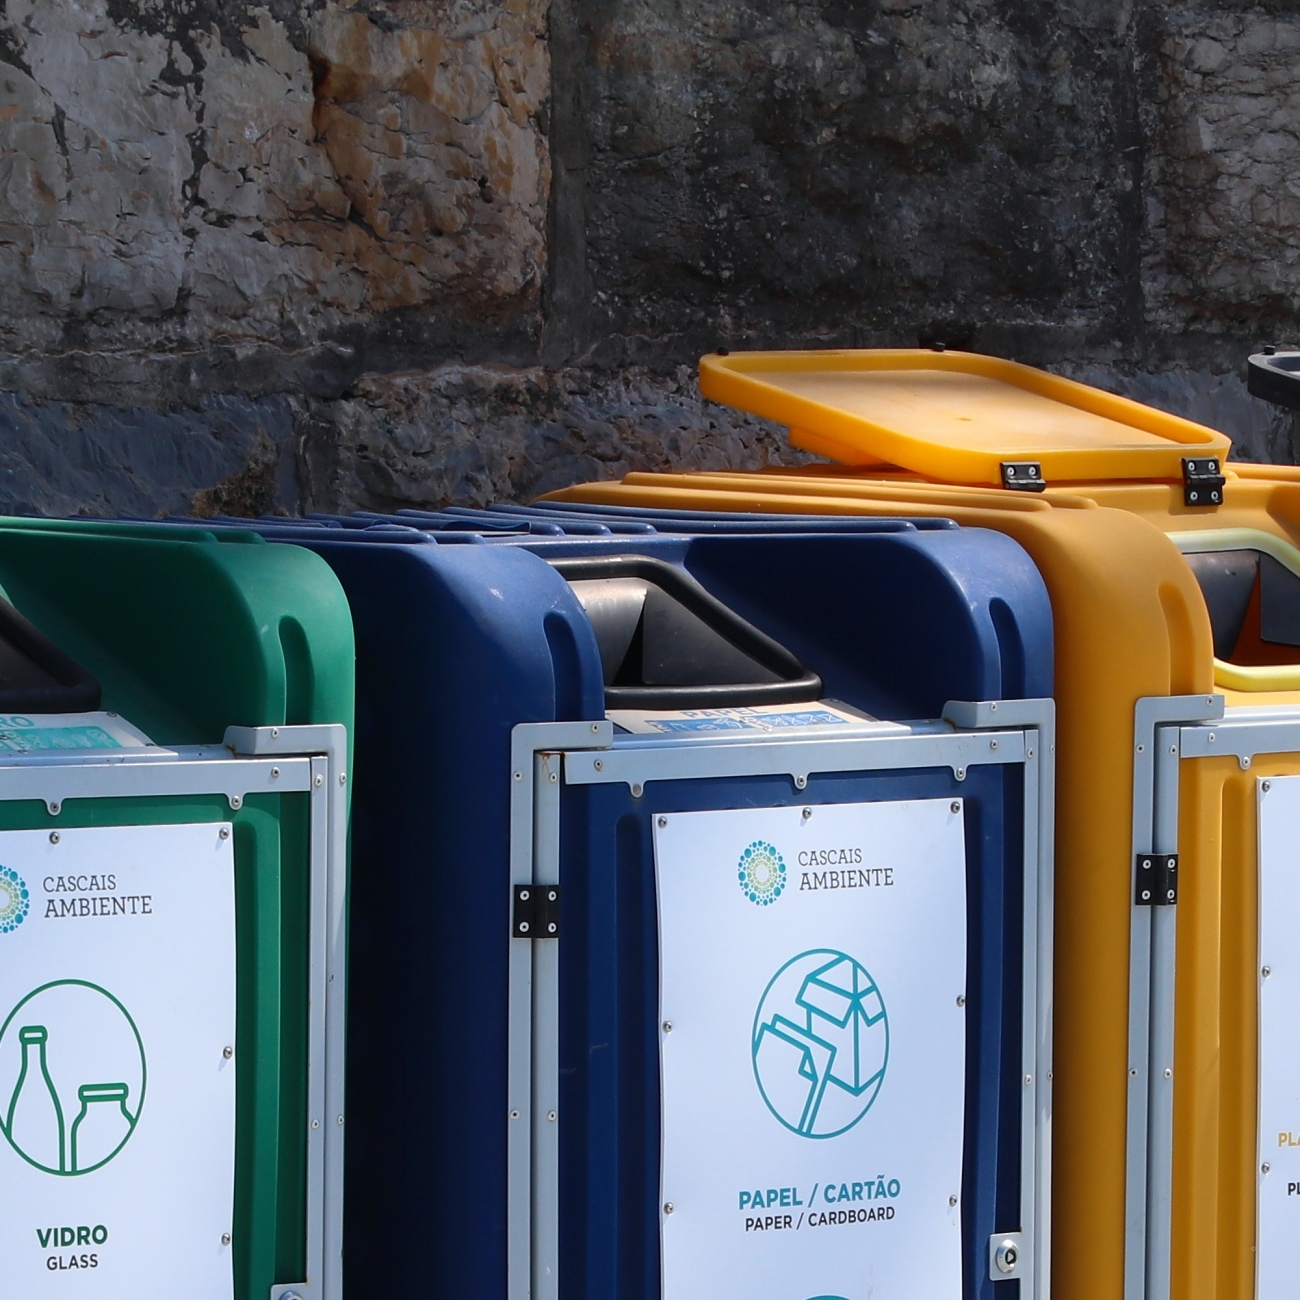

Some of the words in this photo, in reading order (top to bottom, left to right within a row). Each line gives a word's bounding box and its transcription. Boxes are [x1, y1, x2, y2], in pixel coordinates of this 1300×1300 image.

[680, 706, 767, 719] PAPEL
[797, 848, 863, 867] CASCAIS
[42, 874, 117, 893] CASCAIS
[799, 867, 894, 891] AMBIENTE
[44, 895, 153, 919] AMBIENTE
[738, 1187, 803, 1210] PAPEL
[807, 1182, 819, 1208] /
[823, 1174, 901, 1203] CARTÃO
[745, 1214, 793, 1232] PAPER
[796, 1212, 805, 1230] /
[808, 1206, 895, 1227] CARDBOARD
[36, 1224, 108, 1249] VIDRO
[46, 1253, 99, 1271] GLASS
